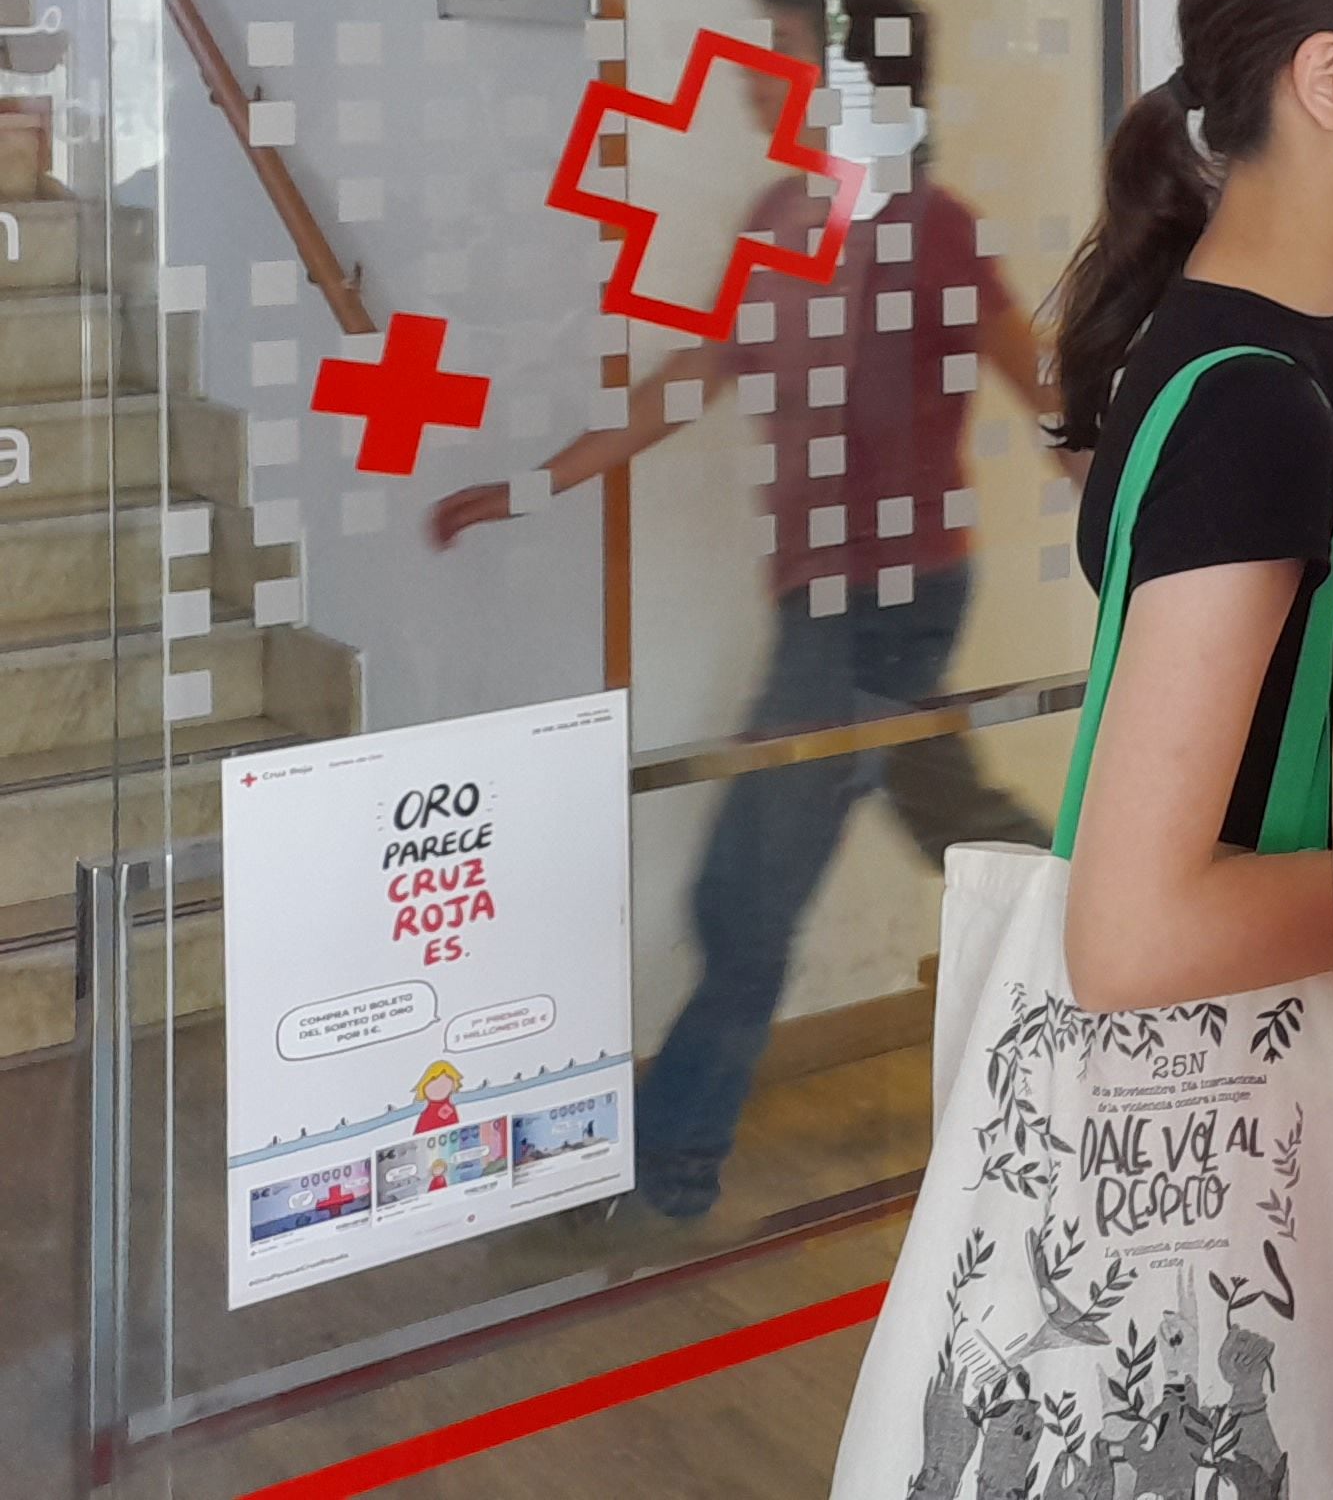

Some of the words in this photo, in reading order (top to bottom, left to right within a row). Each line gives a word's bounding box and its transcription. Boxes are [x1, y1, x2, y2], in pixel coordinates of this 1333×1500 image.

[262, 770, 287, 781] Cruz
[393, 782, 480, 832] ORO
[383, 822, 493, 870] PARECE
[387, 858, 486, 903] CRUZ
[392, 890, 495, 942] ROJA
[423, 935, 471, 966] ES.
[299, 1009, 350, 1028] COMPRA
[352, 1005, 368, 1016] TU
[369, 992, 413, 1010] BOLETO
[299, 1027, 322, 1040] DEL
[324, 1017, 369, 1036] SORTEO
[371, 1012, 387, 1023] DE
[389, 1004, 414, 1018] ORO
[1151, 1050, 1208, 1080] 25N
[1080, 1113, 1153, 1183] DALE
[1161, 1108, 1219, 1174] VOZ
[1225, 1116, 1265, 1158] AL
[1096, 1171, 1231, 1237] RESPETO
